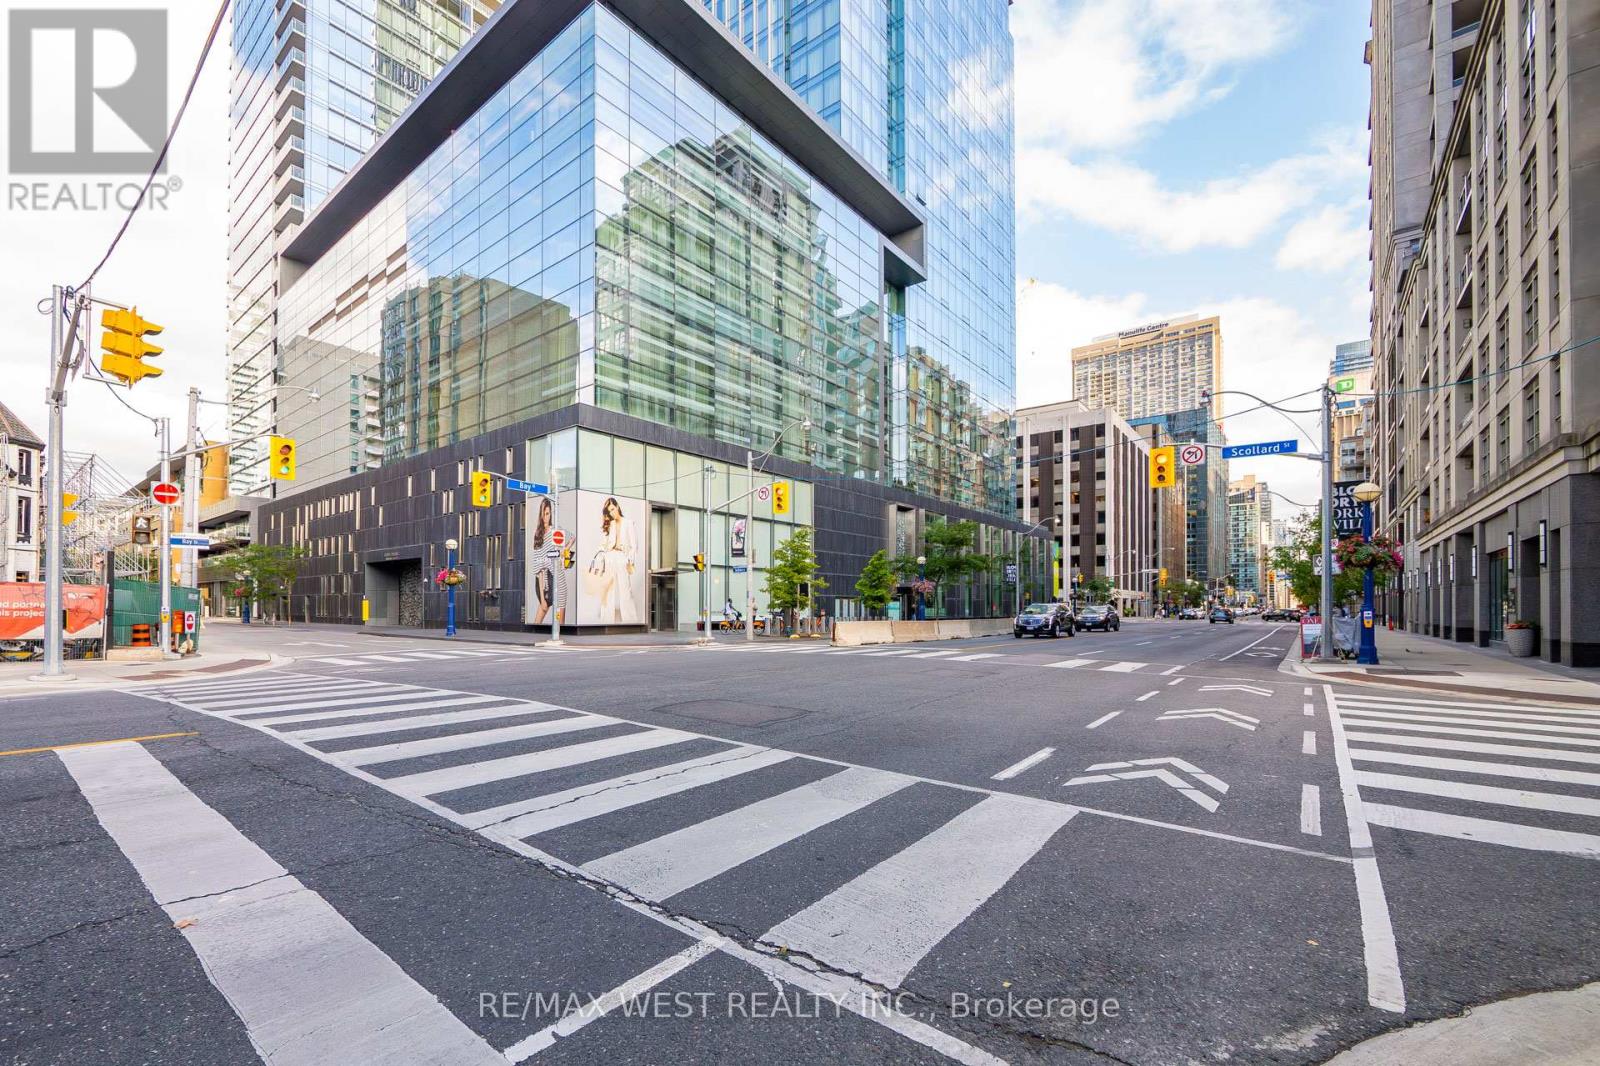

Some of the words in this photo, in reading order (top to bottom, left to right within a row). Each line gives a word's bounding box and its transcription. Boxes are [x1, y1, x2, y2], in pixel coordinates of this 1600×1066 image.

[1118, 327, 1146, 338] Manulife
[1146, 322, 1169, 331] Centre
[1231, 443, 1280, 457] Scollard
[519, 481, 532, 492] Bay
[13, 610, 45, 618] projec
